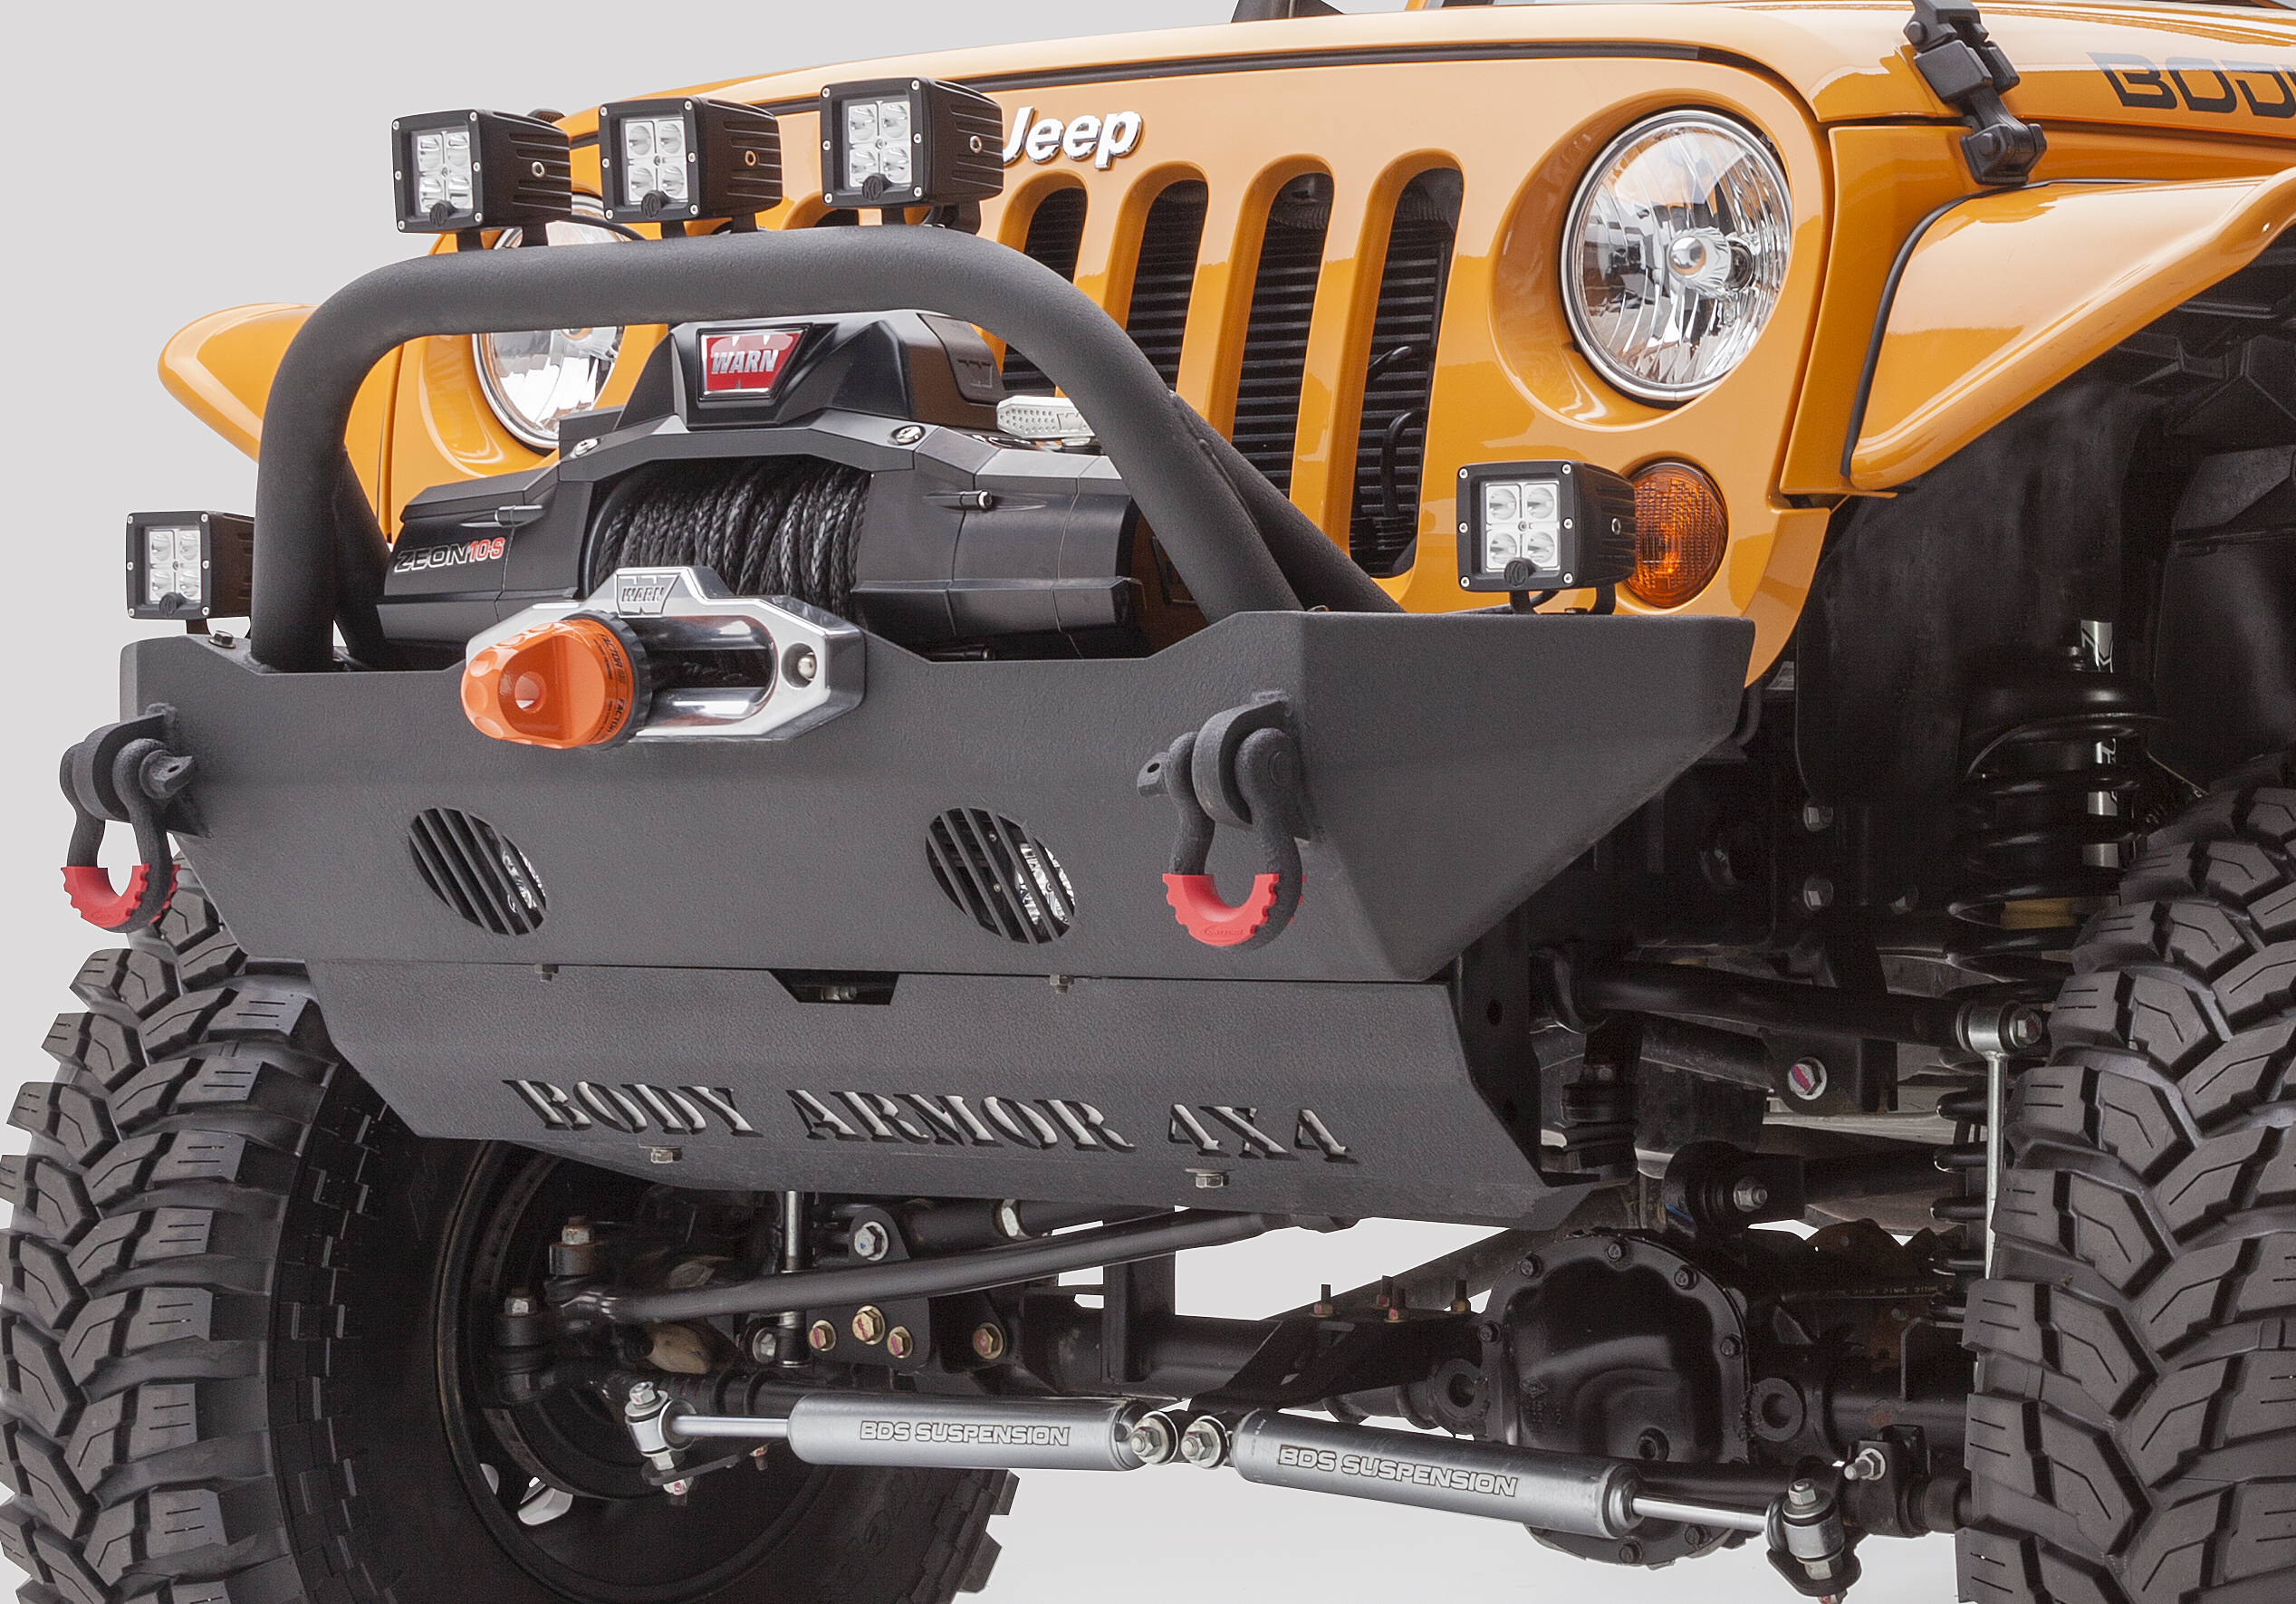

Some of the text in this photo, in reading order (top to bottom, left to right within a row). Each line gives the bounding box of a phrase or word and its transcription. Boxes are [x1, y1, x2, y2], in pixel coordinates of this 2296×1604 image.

[2087, 52, 2296, 119] BOD
[1003, 106, 1143, 169] Jeep
[711, 350, 779, 374] WARN
[621, 586, 664, 602] WARN
[502, 1080, 1359, 1164] BODY ARMOR 4X4
[860, 1420, 1071, 1446] BDS SUSPENSION
[1278, 1445, 1518, 1497] BDS SUSPENSION
